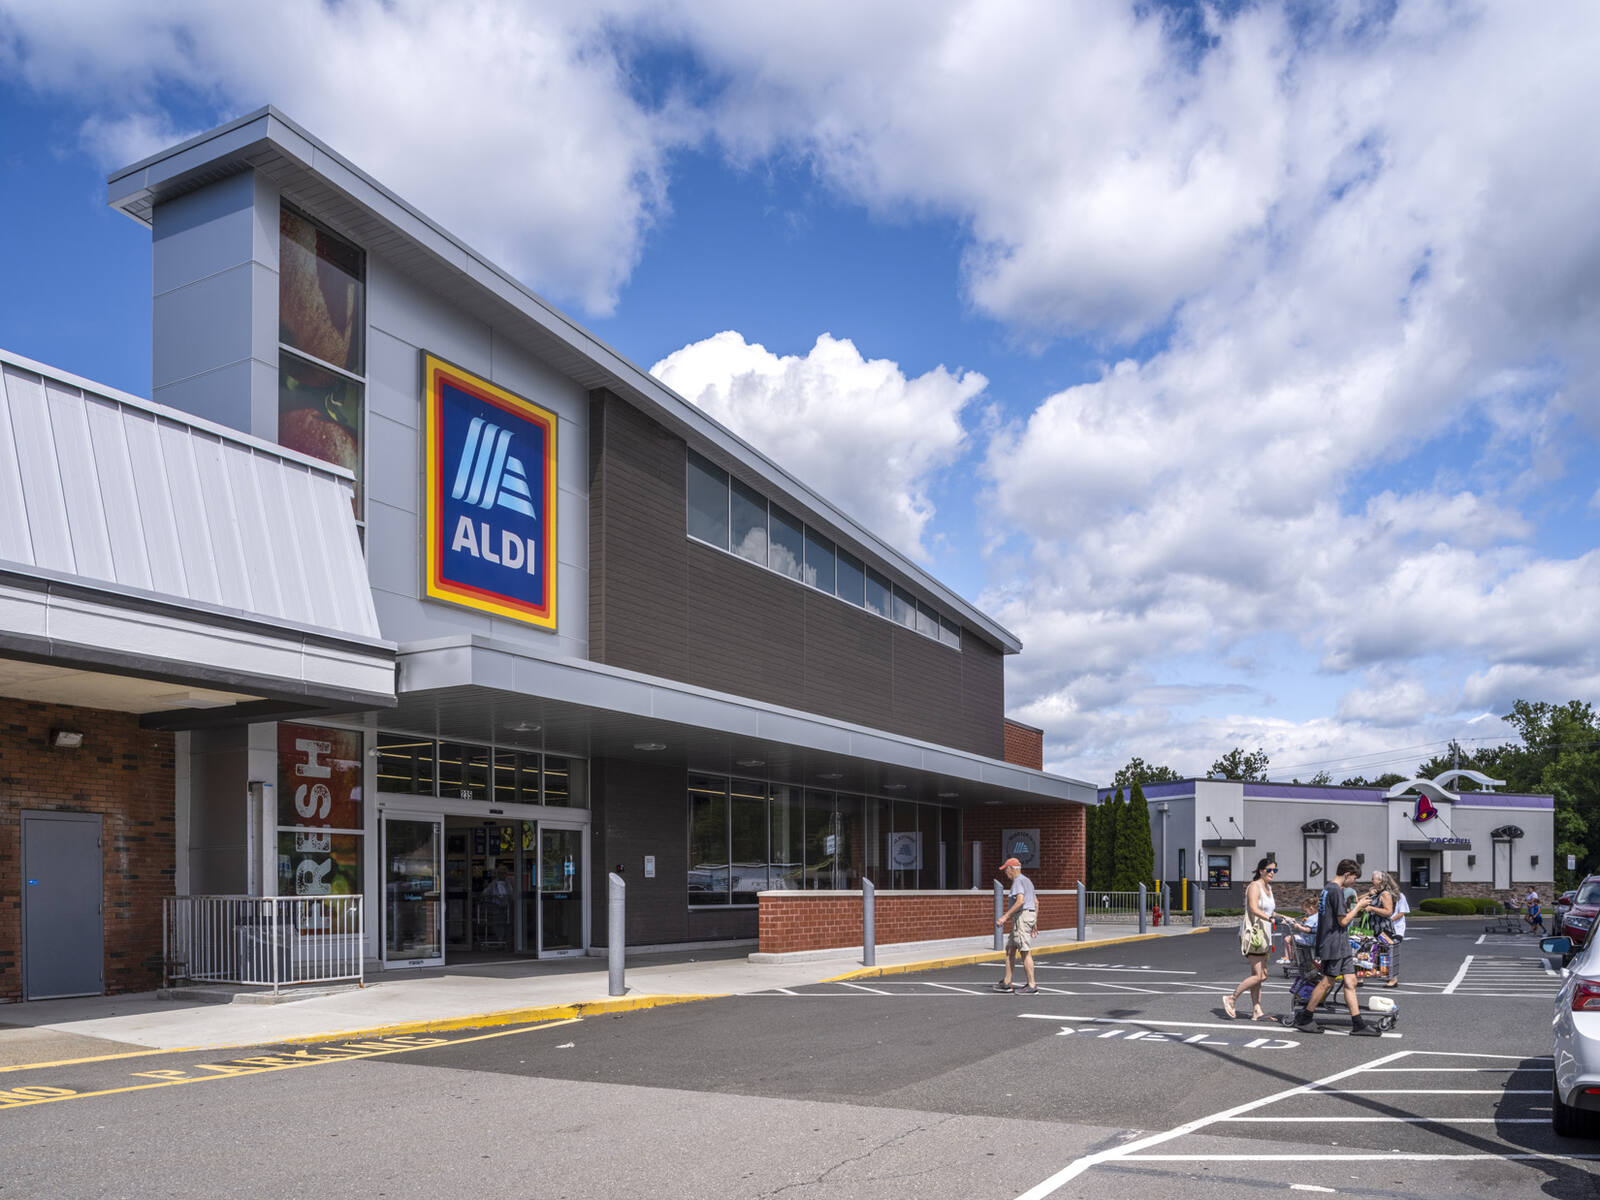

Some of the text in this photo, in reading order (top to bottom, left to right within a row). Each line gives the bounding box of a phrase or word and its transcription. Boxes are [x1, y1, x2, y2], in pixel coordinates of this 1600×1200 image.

[451, 515, 536, 575] ALDI
[295, 738, 332, 929] FRESH
[130, 1036, 448, 1080] PARKING
[1056, 1026, 1302, 1050] YIELD
